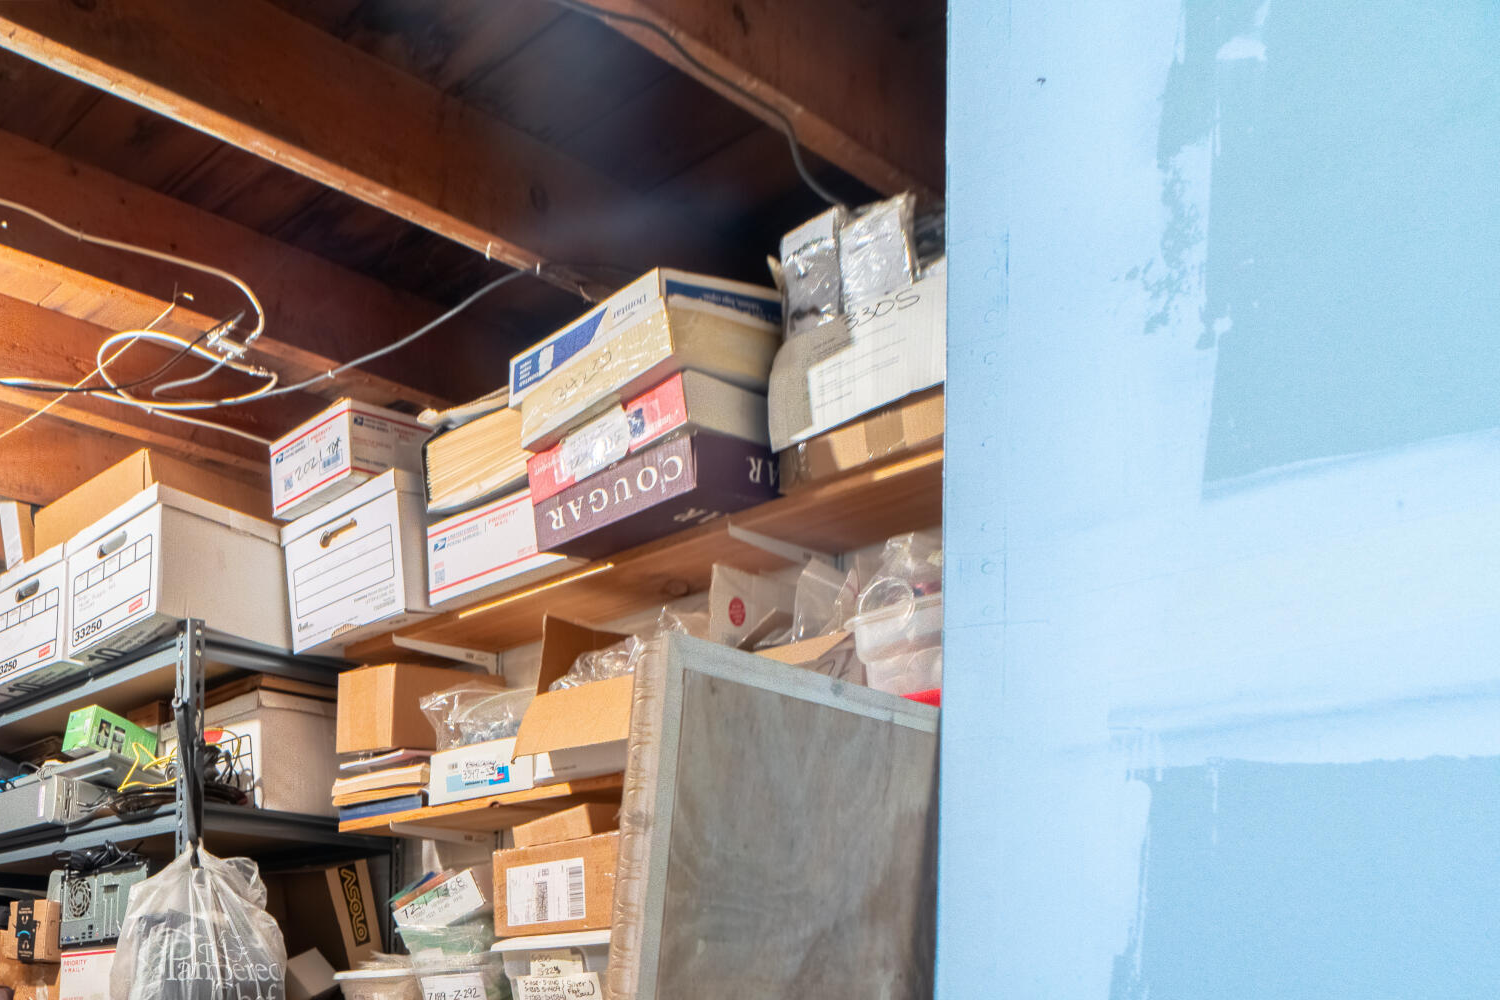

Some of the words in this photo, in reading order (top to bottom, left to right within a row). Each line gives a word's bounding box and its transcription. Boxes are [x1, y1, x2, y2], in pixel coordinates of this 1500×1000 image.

[613, 294, 647, 319] Domtar
[546, 455, 684, 530] COUGAR
[74, 618, 102, 641] 33250
[339, 868, 368, 942] ASOLO
